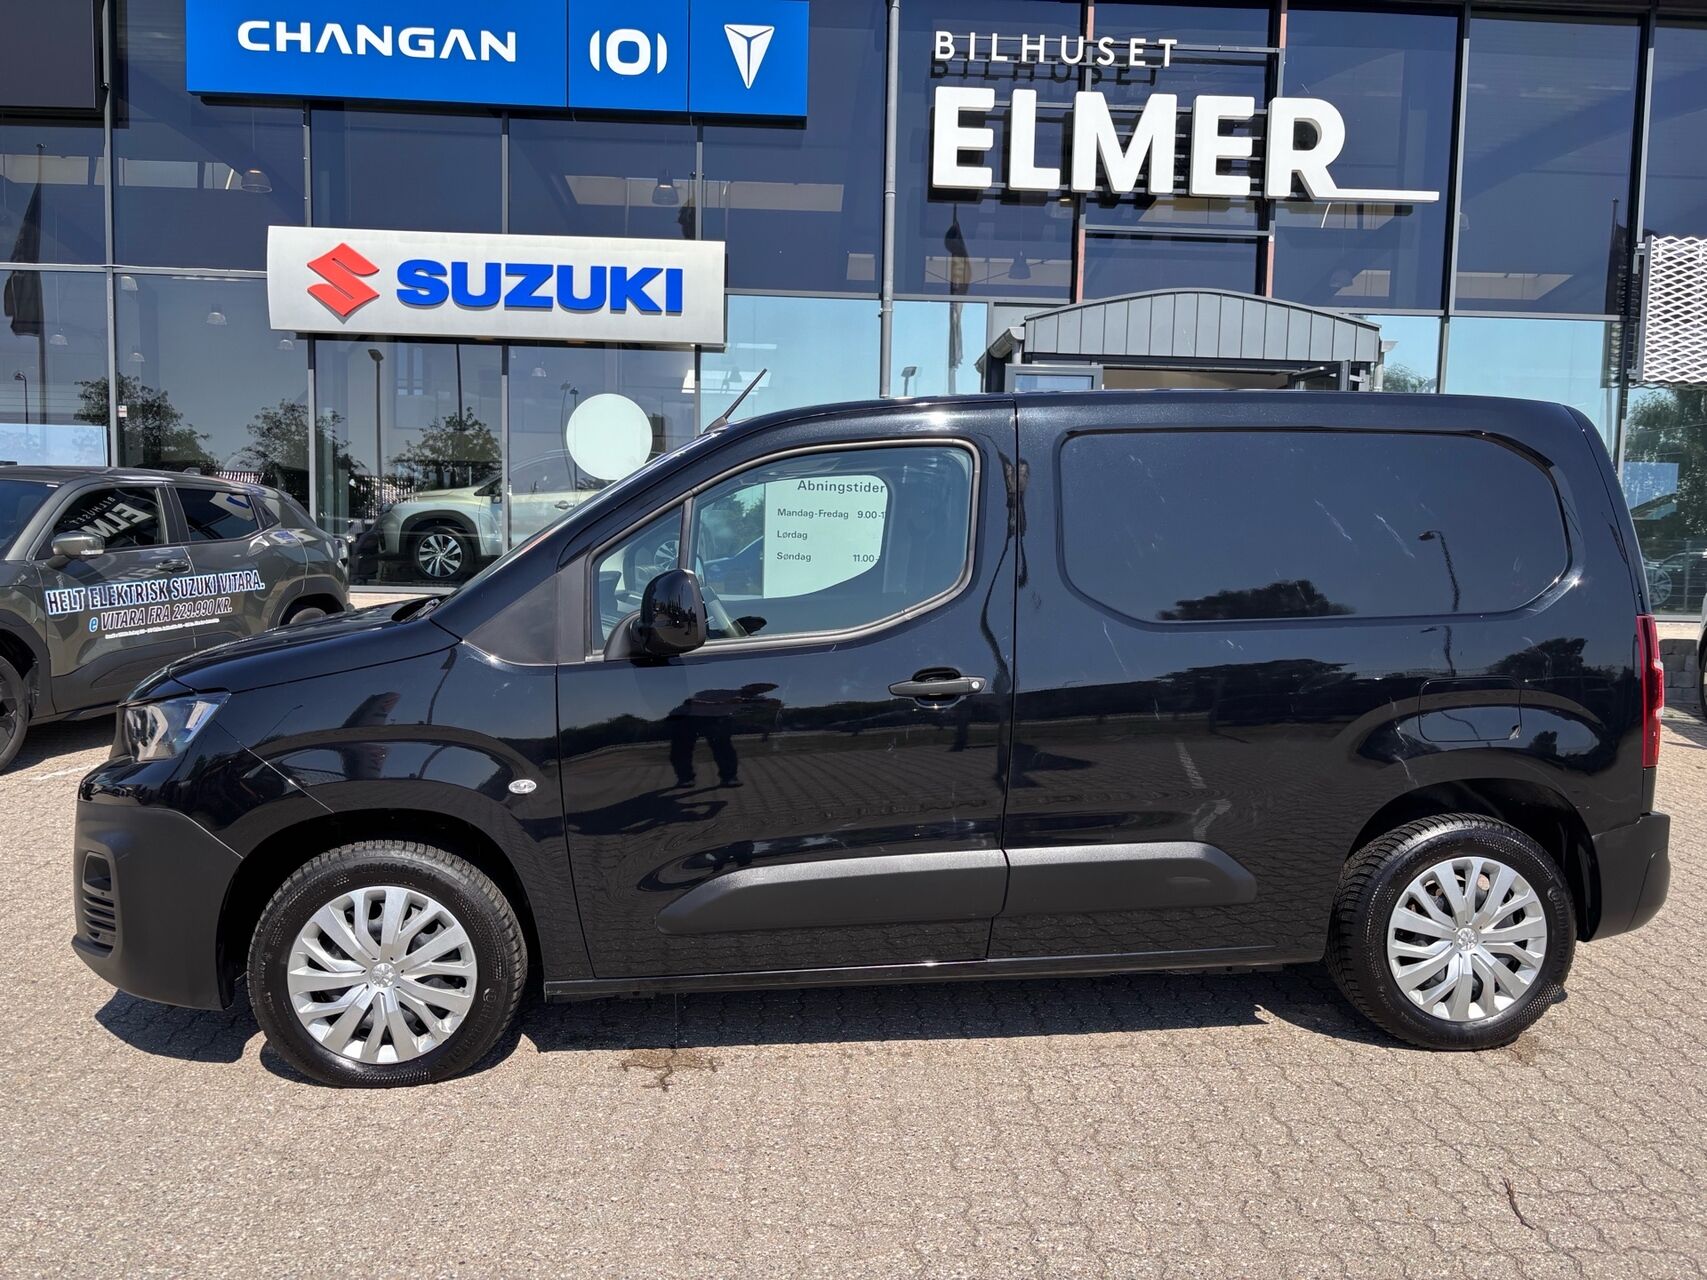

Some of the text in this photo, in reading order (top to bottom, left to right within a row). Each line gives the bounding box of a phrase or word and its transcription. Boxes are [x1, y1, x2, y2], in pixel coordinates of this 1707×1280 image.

[237, 20, 517, 63] CHANGAN
[935, 30, 1178, 67] BILHUSET
[932, 85, 1440, 202] ELMER
[396, 258, 684, 315] SUZUKI
[777, 530, 808, 541] Lørdag
[777, 552, 812, 563] Søndag
[45, 570, 265, 615] HELT ELEKTRISK SUZUKI VITARA.
[89, 617, 99, 632] e
[101, 607, 145, 631] VITARA
[147, 605, 171, 624] FRA
[172, 600, 215, 621] 229.990
[215, 597, 233, 615] KR.
